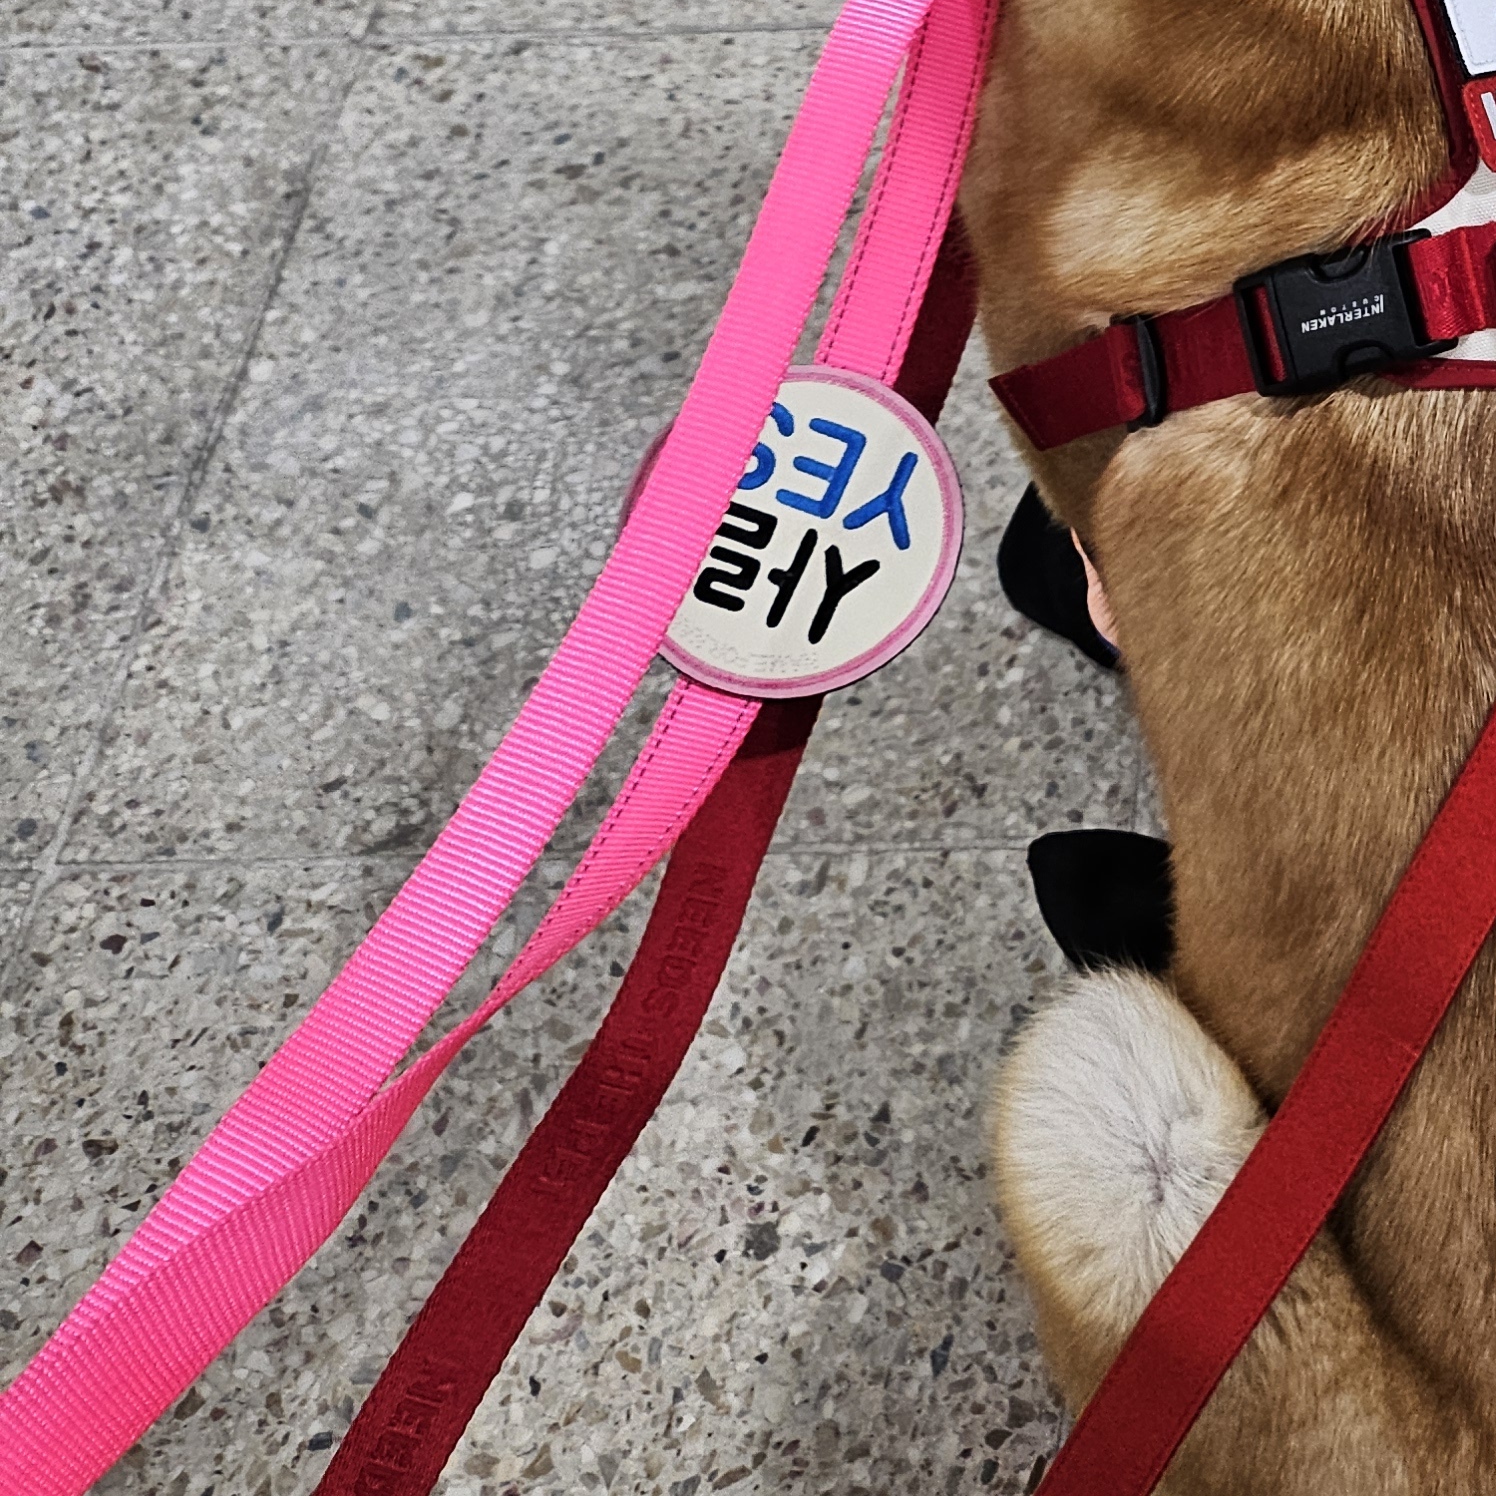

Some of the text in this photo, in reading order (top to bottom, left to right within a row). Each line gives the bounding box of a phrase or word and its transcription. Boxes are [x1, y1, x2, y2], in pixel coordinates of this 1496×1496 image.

[1301, 294, 1384, 333] INTERLAKEN
[1319, 294, 1380, 316] CUSTOM
[640, 859, 730, 1021] NEEDS
